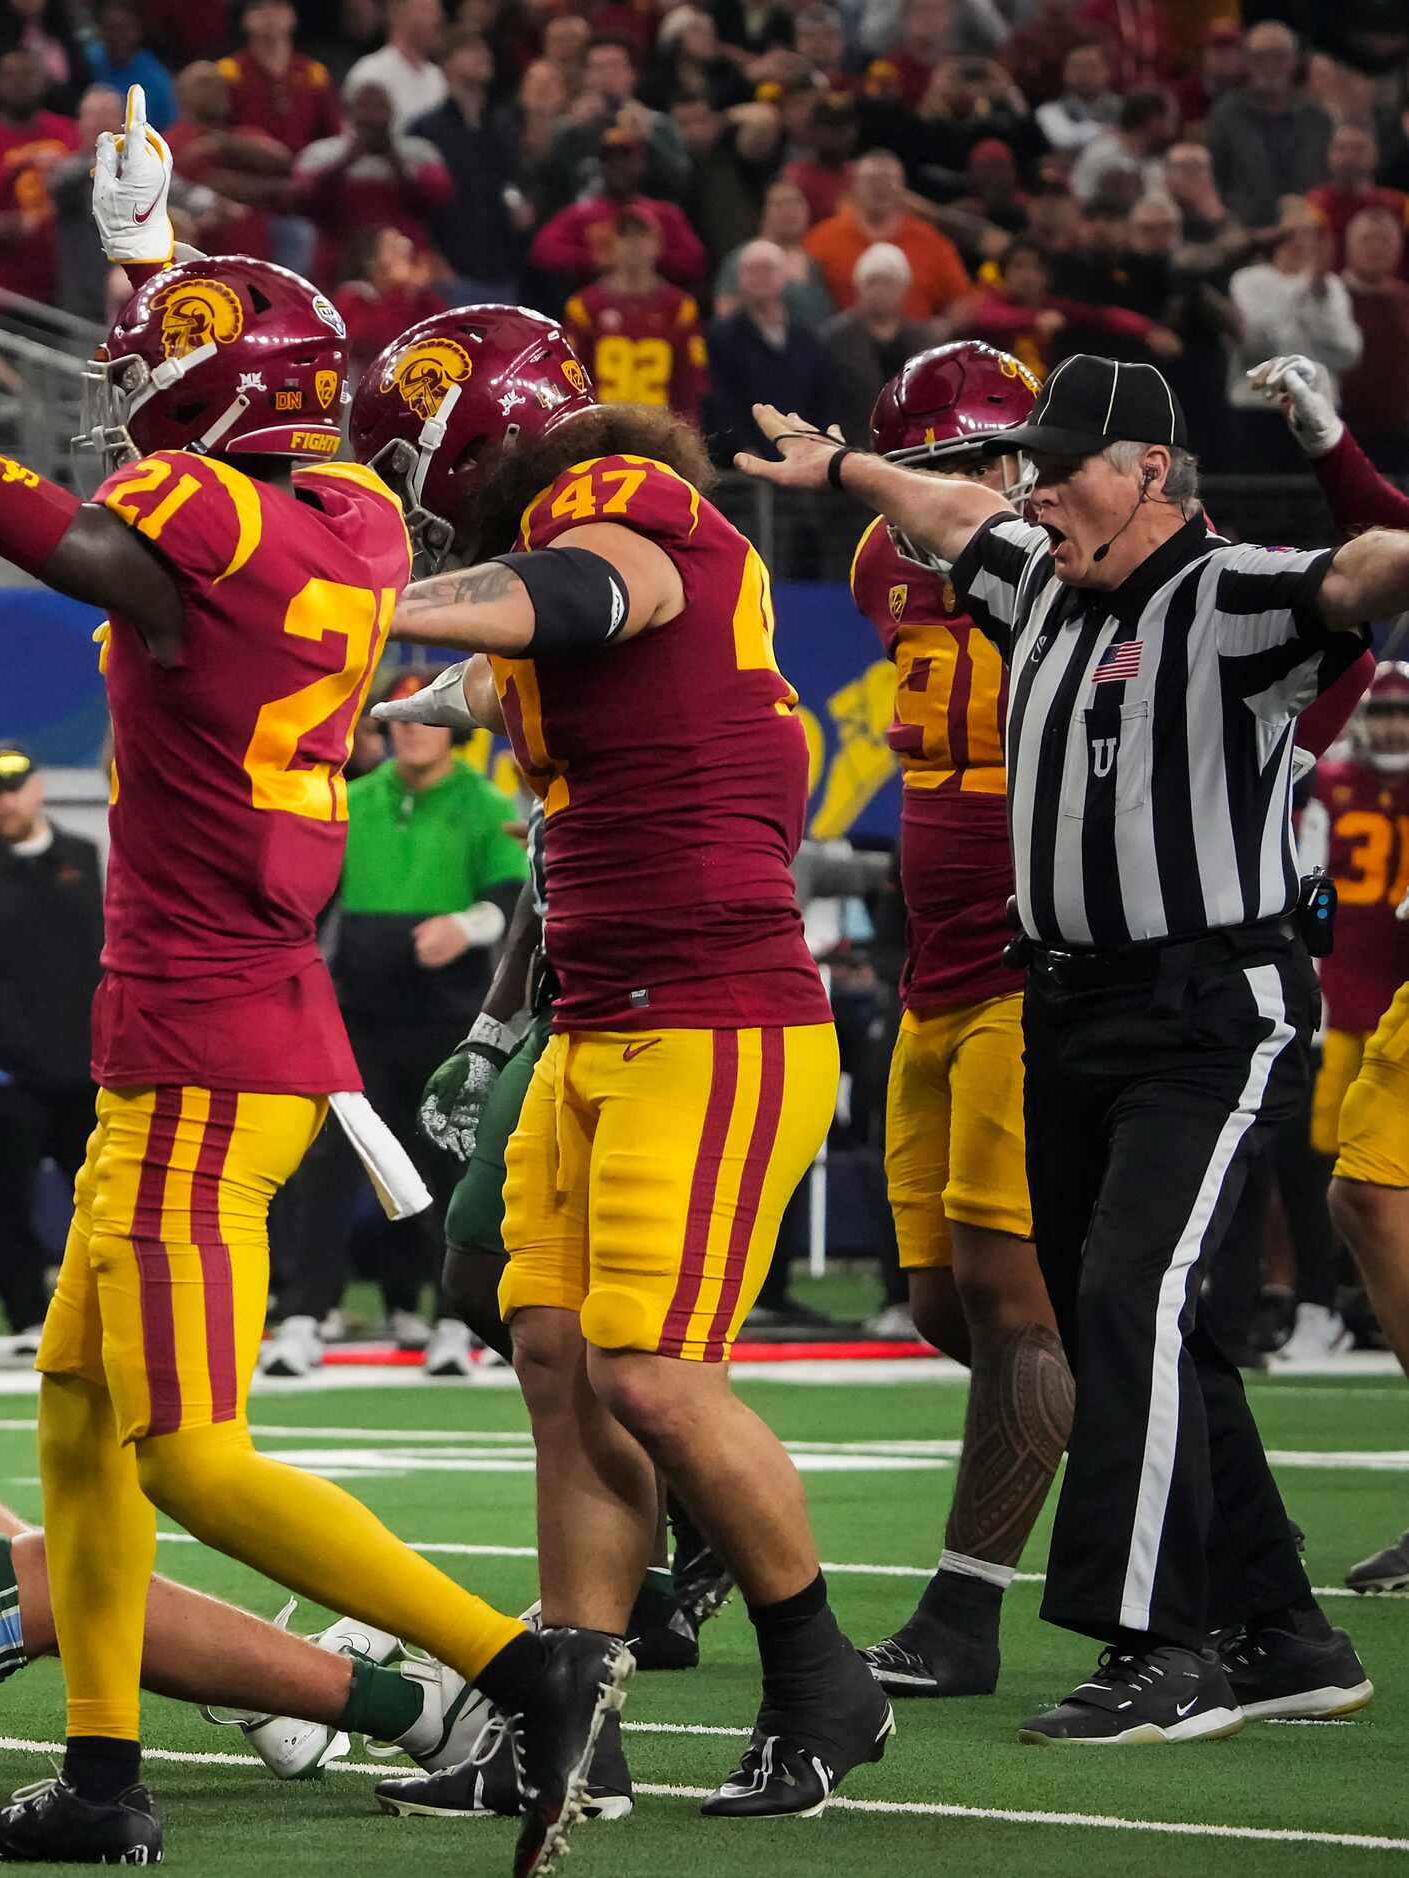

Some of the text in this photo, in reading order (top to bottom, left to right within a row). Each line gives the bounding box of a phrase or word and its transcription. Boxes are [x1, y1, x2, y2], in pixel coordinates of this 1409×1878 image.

[596, 335, 672, 405] 92
[105, 458, 202, 540] 21
[551, 469, 647, 520] 47
[895, 625, 1008, 794] 91
[1092, 737, 1116, 777] U
